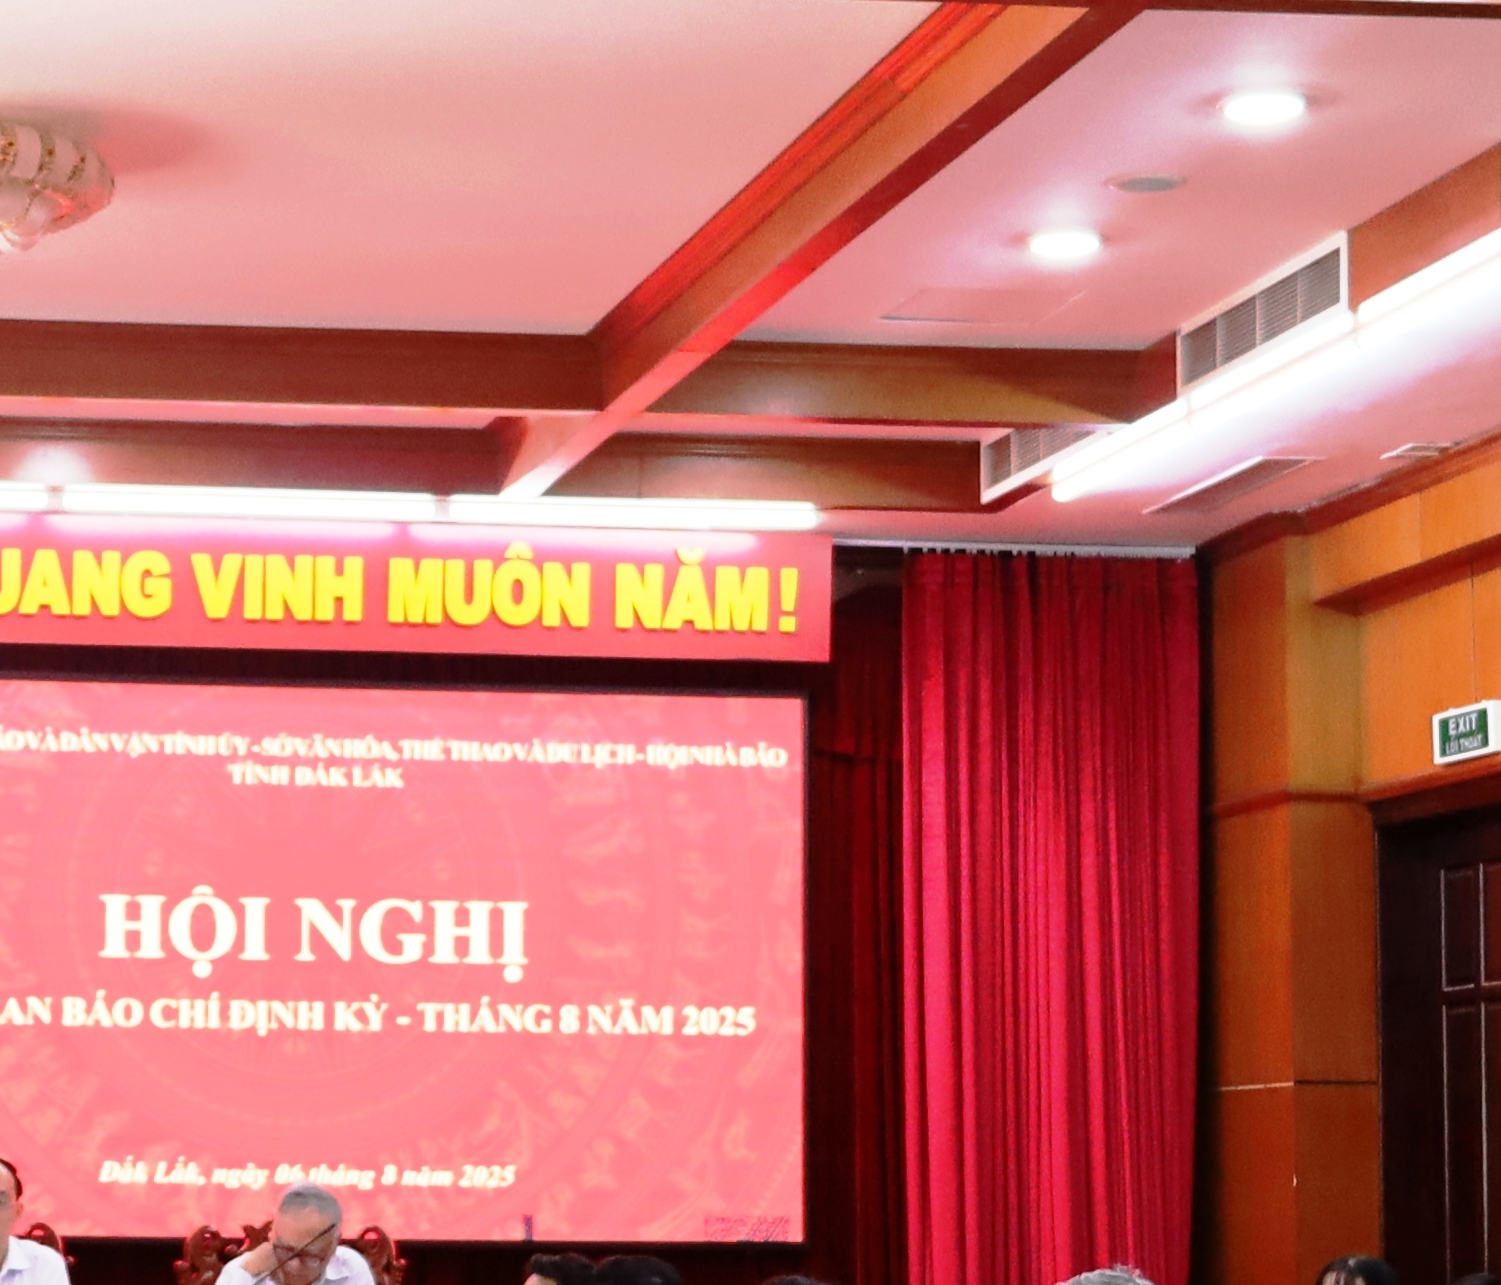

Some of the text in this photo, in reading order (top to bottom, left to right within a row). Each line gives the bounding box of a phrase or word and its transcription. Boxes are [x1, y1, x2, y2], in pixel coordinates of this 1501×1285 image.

[191, 552, 363, 623] VINH
[388, 541, 590, 629] MUÔN
[1449, 713, 1477, 735] EXIT
[447, 738, 514, 763] THAO
[98, 885, 529, 984] HỘI NGHỊ
[61, 989, 145, 1028] BÁO
[149, 990, 221, 1029] CHÍ
[228, 998, 325, 1038] ĐỊNH
[417, 995, 552, 1034] THÁNG
[558, 1003, 581, 1034] 8
[586, 998, 675, 1036] NĂM
[681, 1005, 757, 1037] 2025
[380, 1162, 398, 1186] 8
[457, 1164, 518, 1188] 2025
